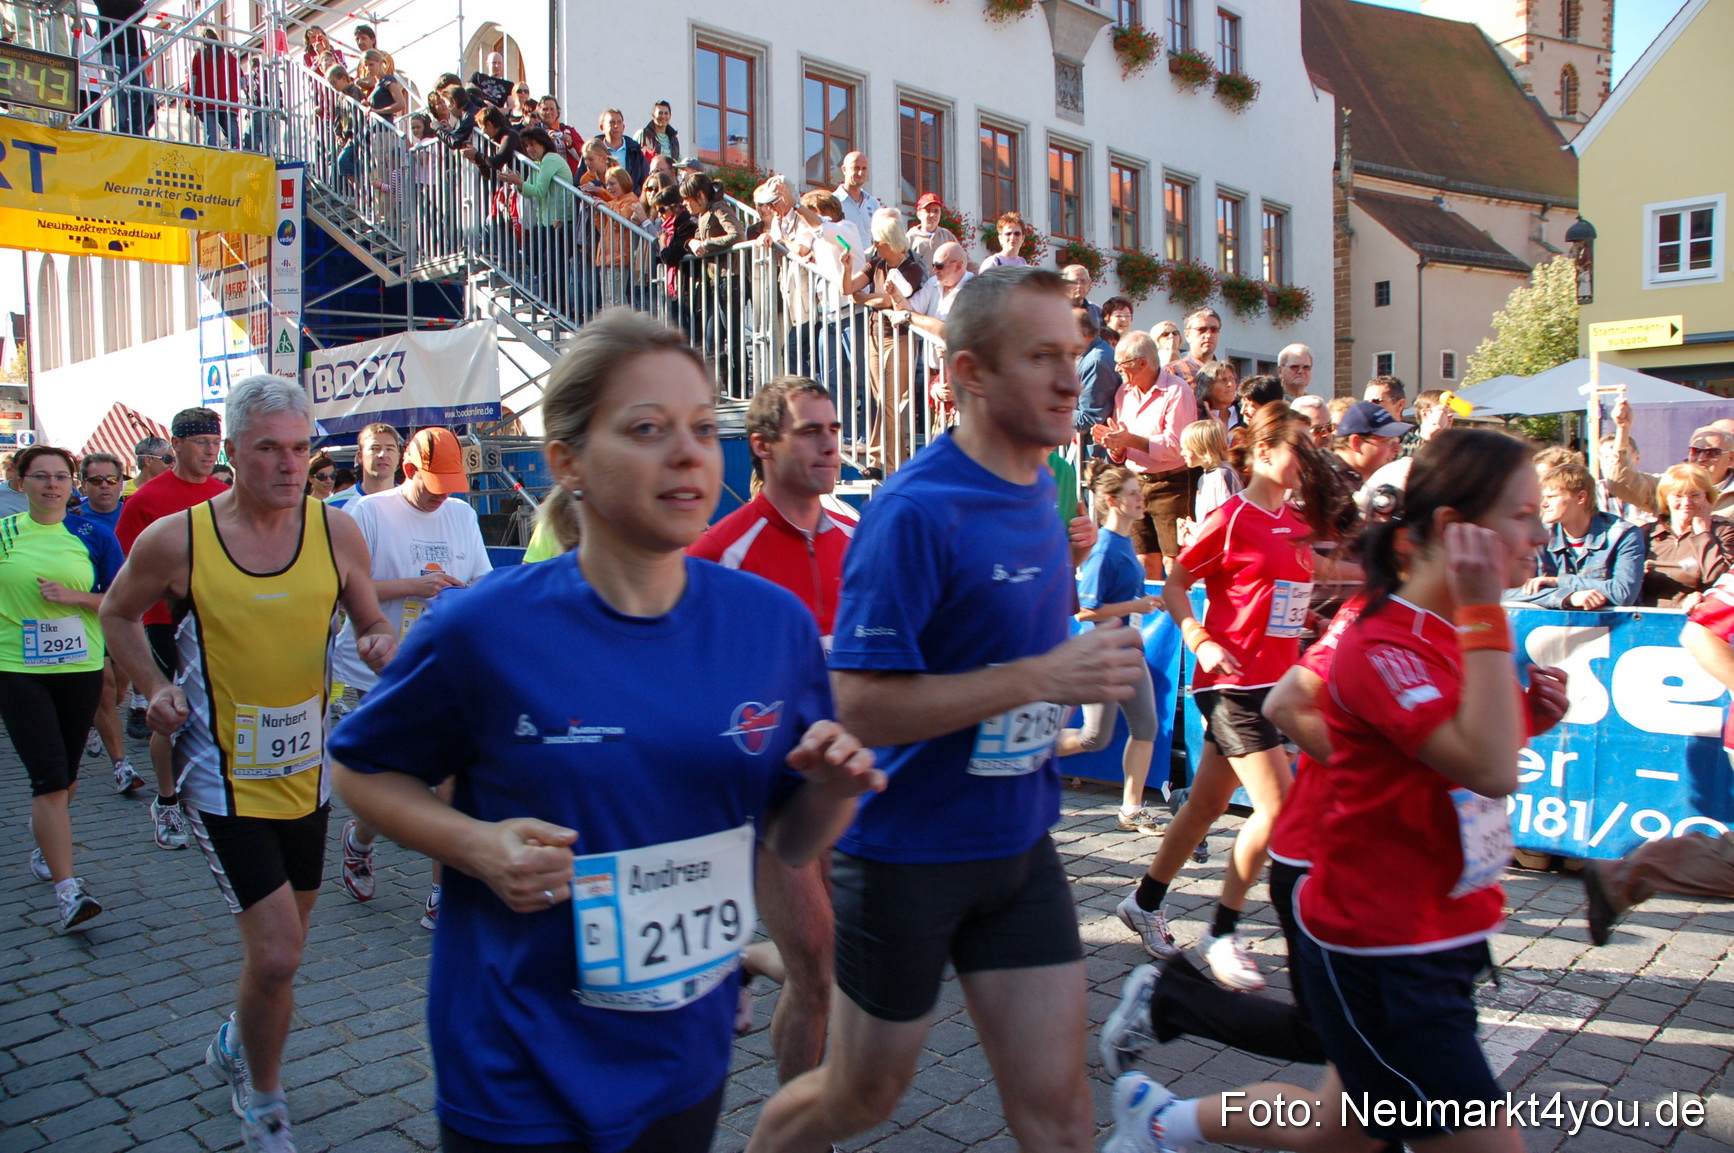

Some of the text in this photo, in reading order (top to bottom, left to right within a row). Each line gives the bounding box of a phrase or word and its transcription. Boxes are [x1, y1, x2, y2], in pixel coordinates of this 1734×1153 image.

[104, 181, 242, 208] Neumarkter Stadtlauf
[111, 226, 162, 240] Stadtlauf
[1593, 323, 1665, 337] Startnummern-
[1608, 335, 1649, 347] ausgabe
[313, 351, 406, 403] BOCK
[40, 623, 58, 633] Elke
[43, 635, 82, 653] 2921
[262, 710, 307, 728] Norbert
[238, 733, 245, 745] D
[271, 731, 311, 758] 912
[628, 859, 712, 895] Andrea
[640, 898, 743, 967] 2179
